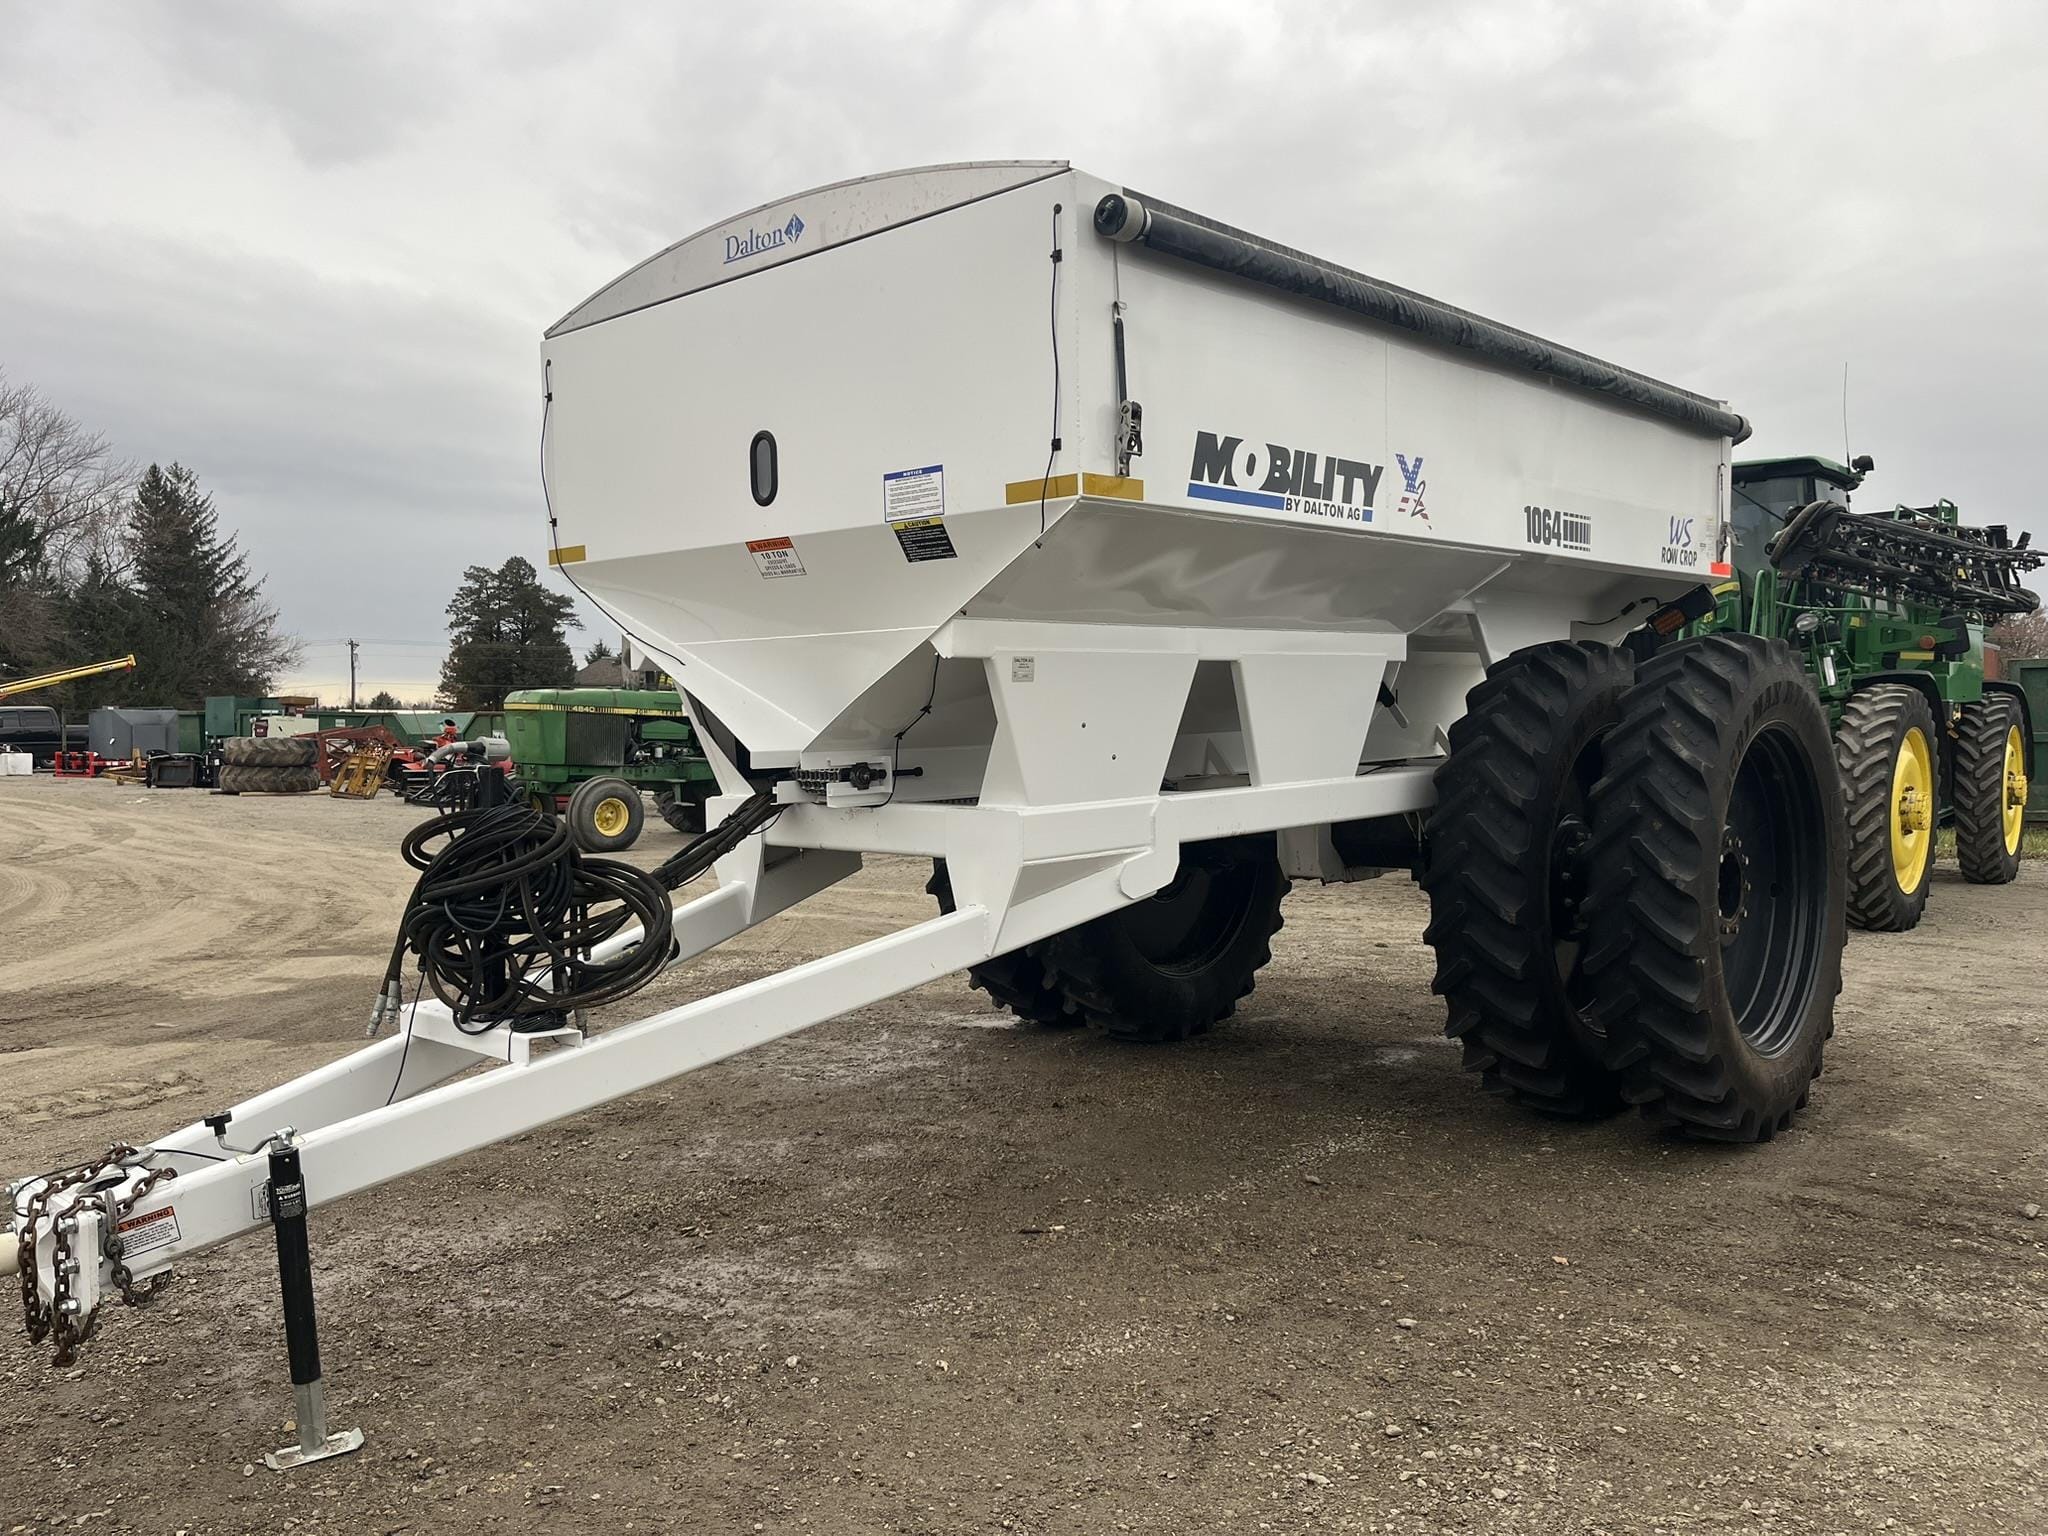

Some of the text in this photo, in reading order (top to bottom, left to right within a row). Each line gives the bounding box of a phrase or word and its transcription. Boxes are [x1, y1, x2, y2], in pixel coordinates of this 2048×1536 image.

[725, 227, 784, 260] Dalton
[903, 469, 922, 477] NOTICE
[1190, 430, 1384, 508] MOBILITY
[1286, 498, 1361, 520] BY DALTON AG
[907, 519, 931, 528] CAUTION
[1524, 505, 1562, 547] 1064
[1670, 515, 1694, 548] WS
[756, 539, 791, 550] WARNING
[771, 550, 789, 559] TON
[1661, 547, 1697, 567] ROW CROP
[127, 1209, 170, 1228] WARNING
